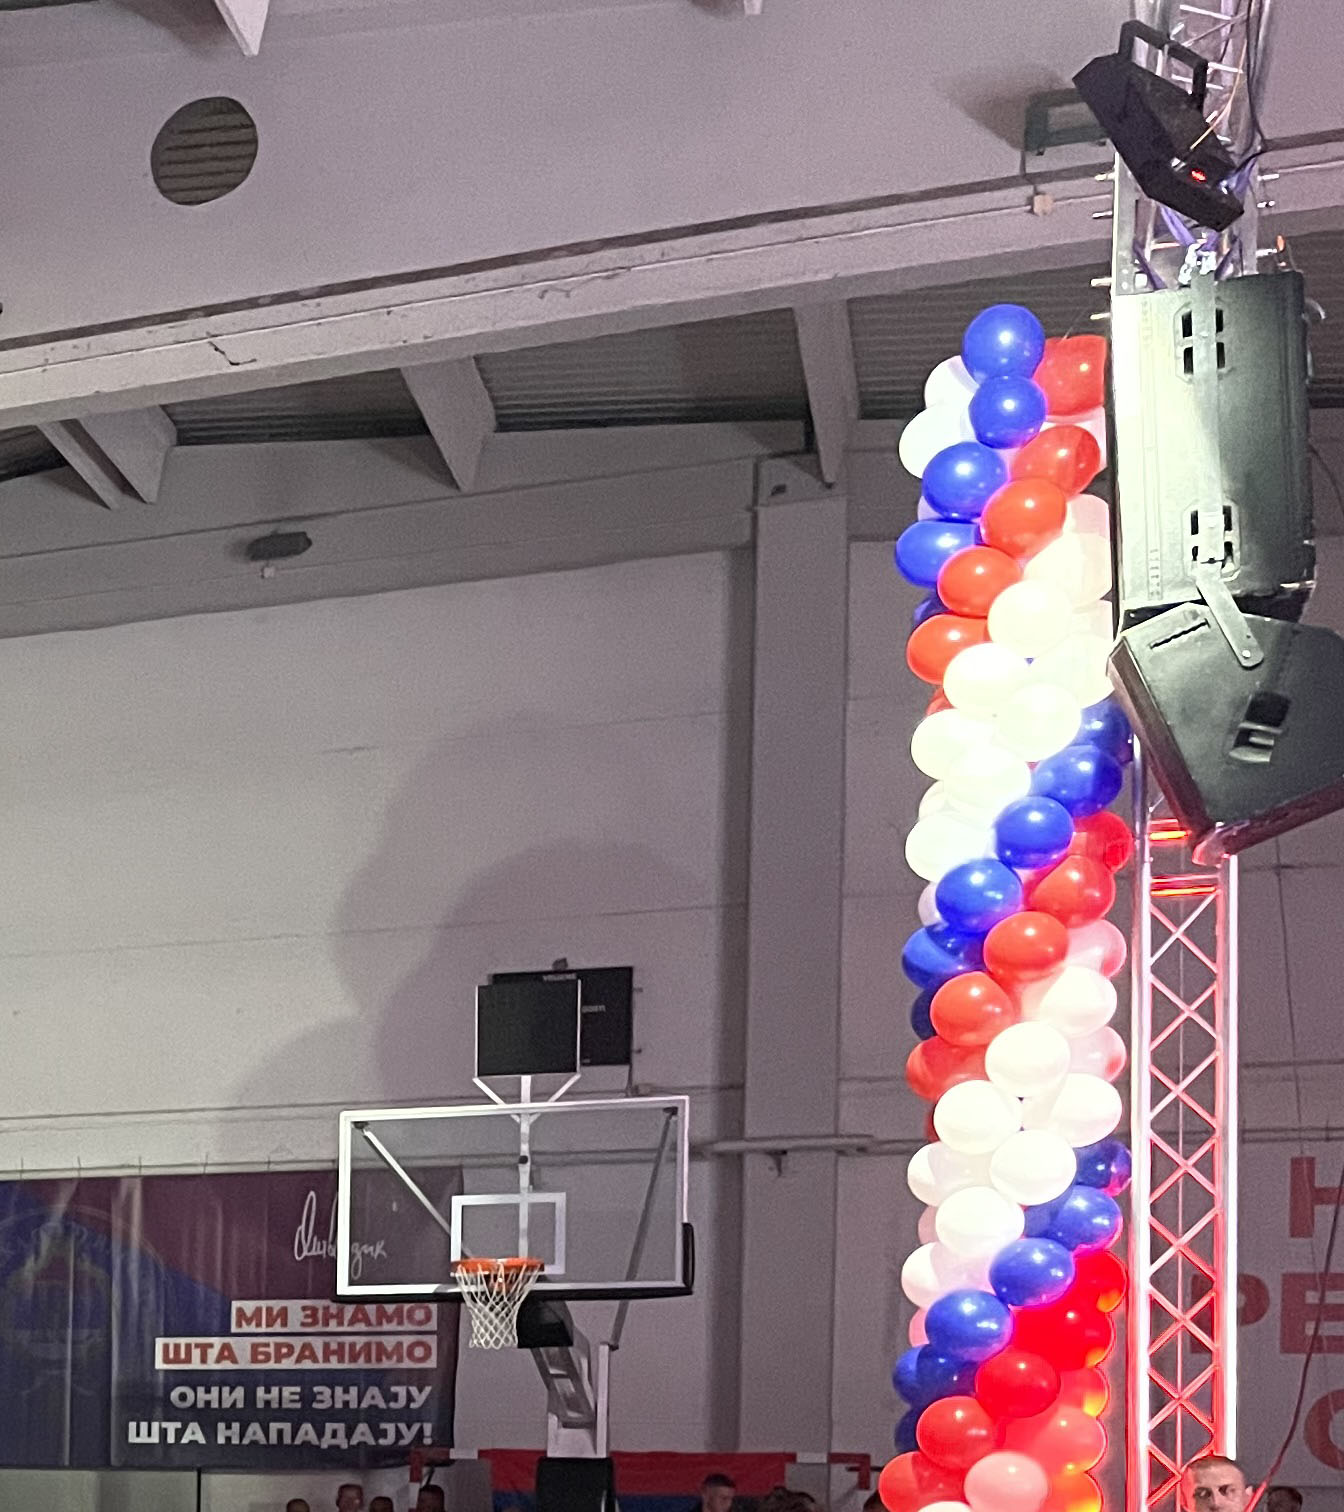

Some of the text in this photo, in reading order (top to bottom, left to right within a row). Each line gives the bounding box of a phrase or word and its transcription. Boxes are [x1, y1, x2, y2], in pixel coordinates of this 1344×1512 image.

[235, 1304, 432, 1328] МИ ЗНАМО
[162, 1341, 433, 1365] ШТА БРАНИМО
[170, 1386, 432, 1409] ОНИ НЕ ЗНАЈУ
[128, 1421, 433, 1449] ШТА НАПАДАЈУ!
